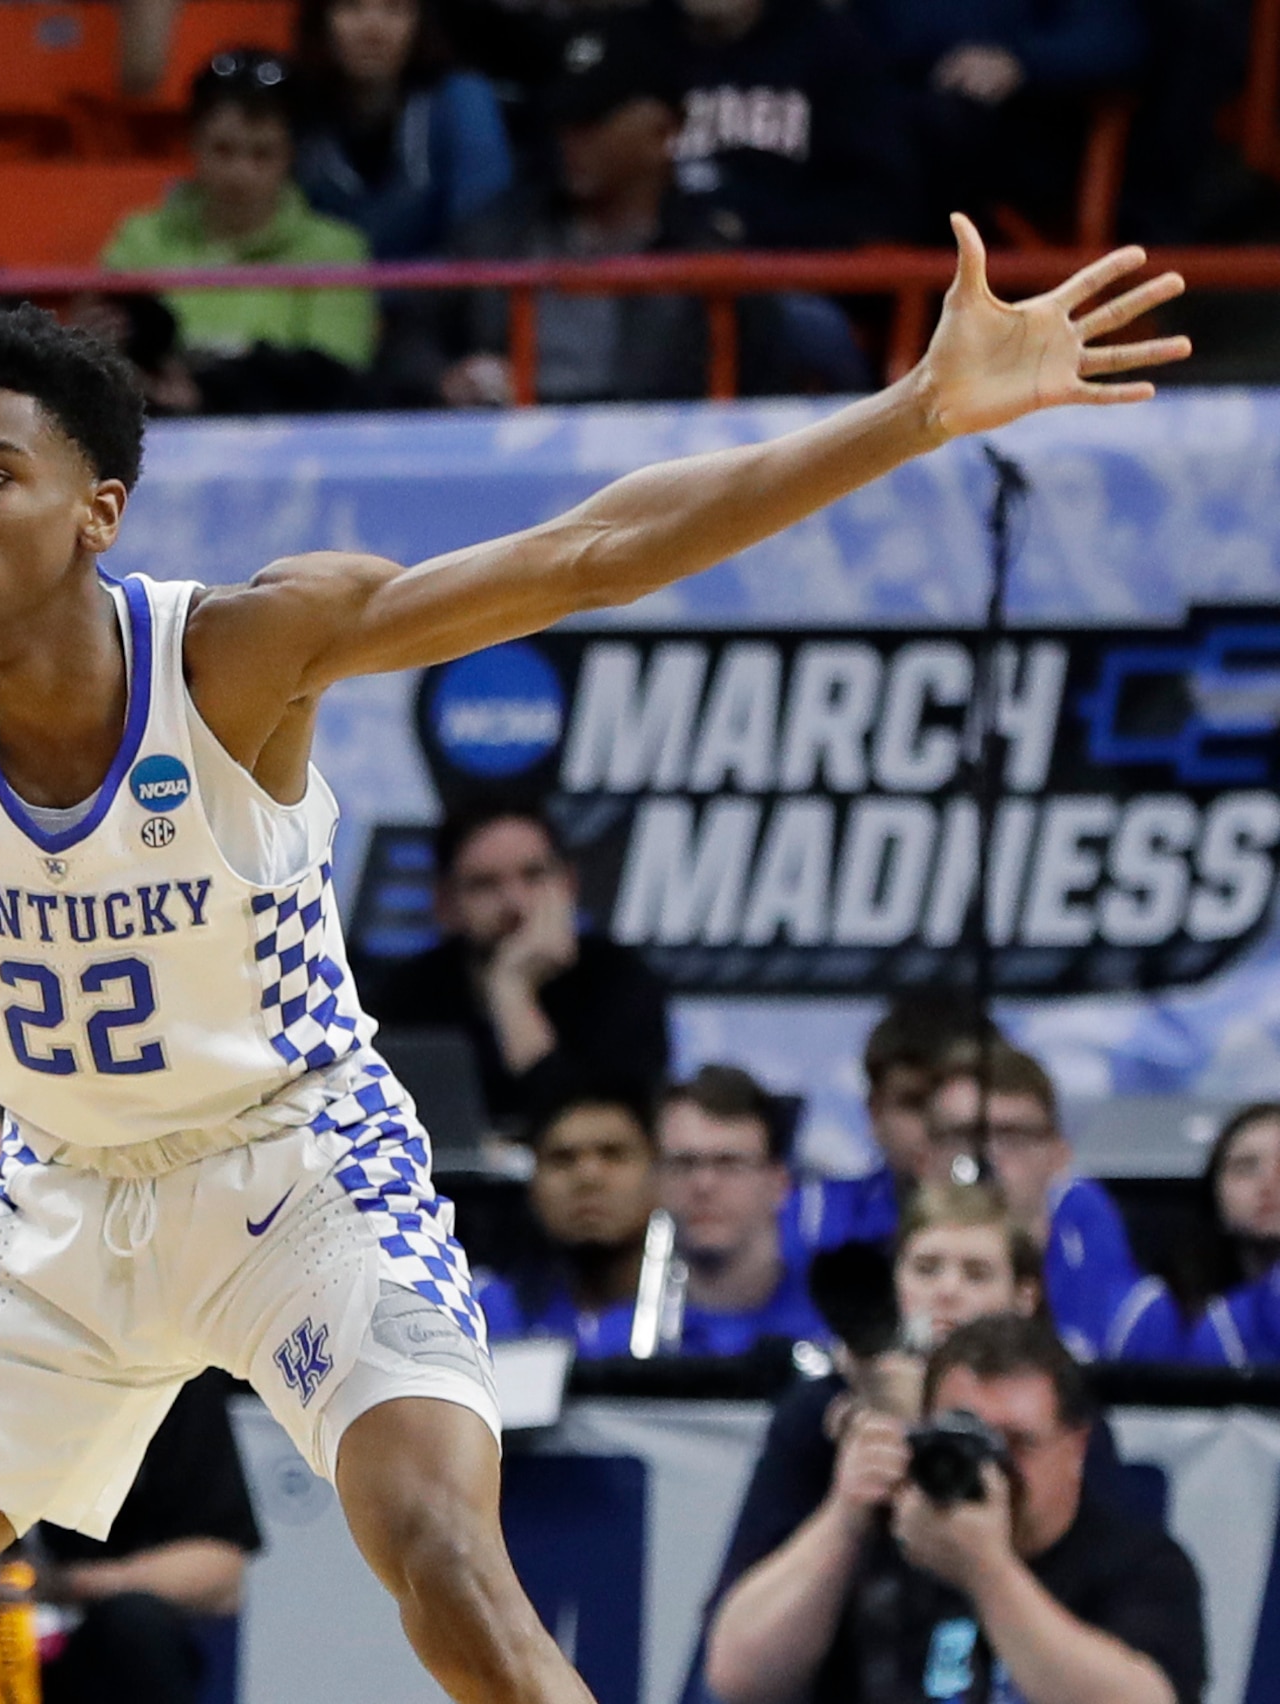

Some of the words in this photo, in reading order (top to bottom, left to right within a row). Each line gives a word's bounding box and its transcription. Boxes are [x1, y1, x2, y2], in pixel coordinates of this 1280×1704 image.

[560, 640, 1069, 792] MARCH
[139, 778, 188, 800] NCAA
[142, 818, 175, 848] SEC
[610, 791, 1277, 948] MADNESS
[272, 1315, 334, 1409] UK
